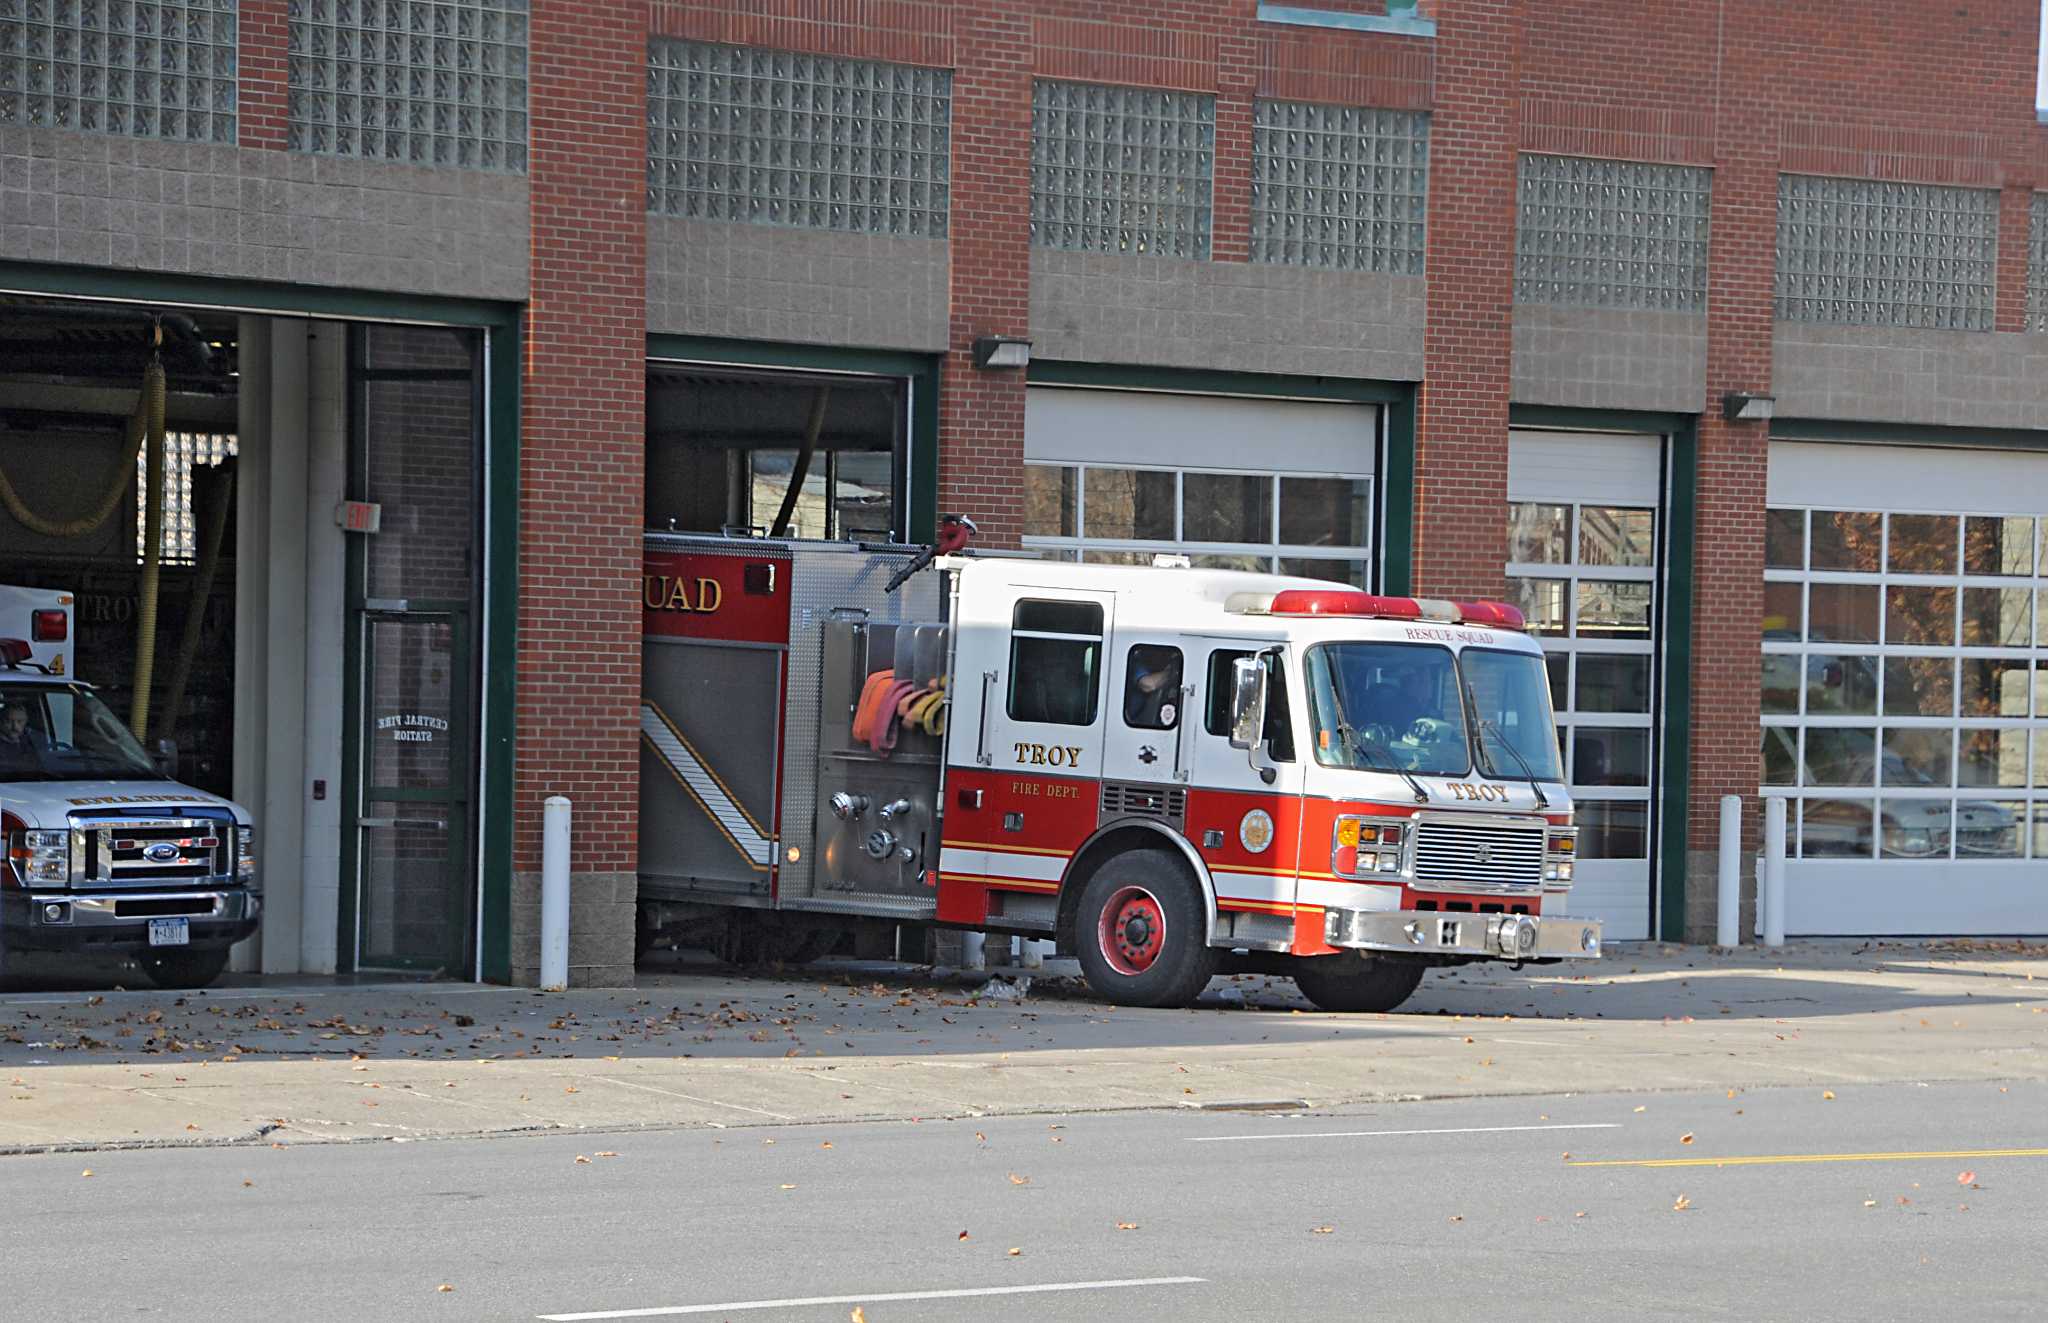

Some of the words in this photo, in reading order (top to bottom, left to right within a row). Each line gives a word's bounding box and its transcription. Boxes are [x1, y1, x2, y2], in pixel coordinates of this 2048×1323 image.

[348, 504, 375, 529] EXIT
[1406, 628, 1453, 641] RESCUE
[1456, 630, 1494, 645] SQUAD
[48, 653, 65, 675] 4
[1014, 743, 1083, 767] TROY
[1012, 781, 1040, 796] FIRE
[1447, 783, 1509, 802] TROY
